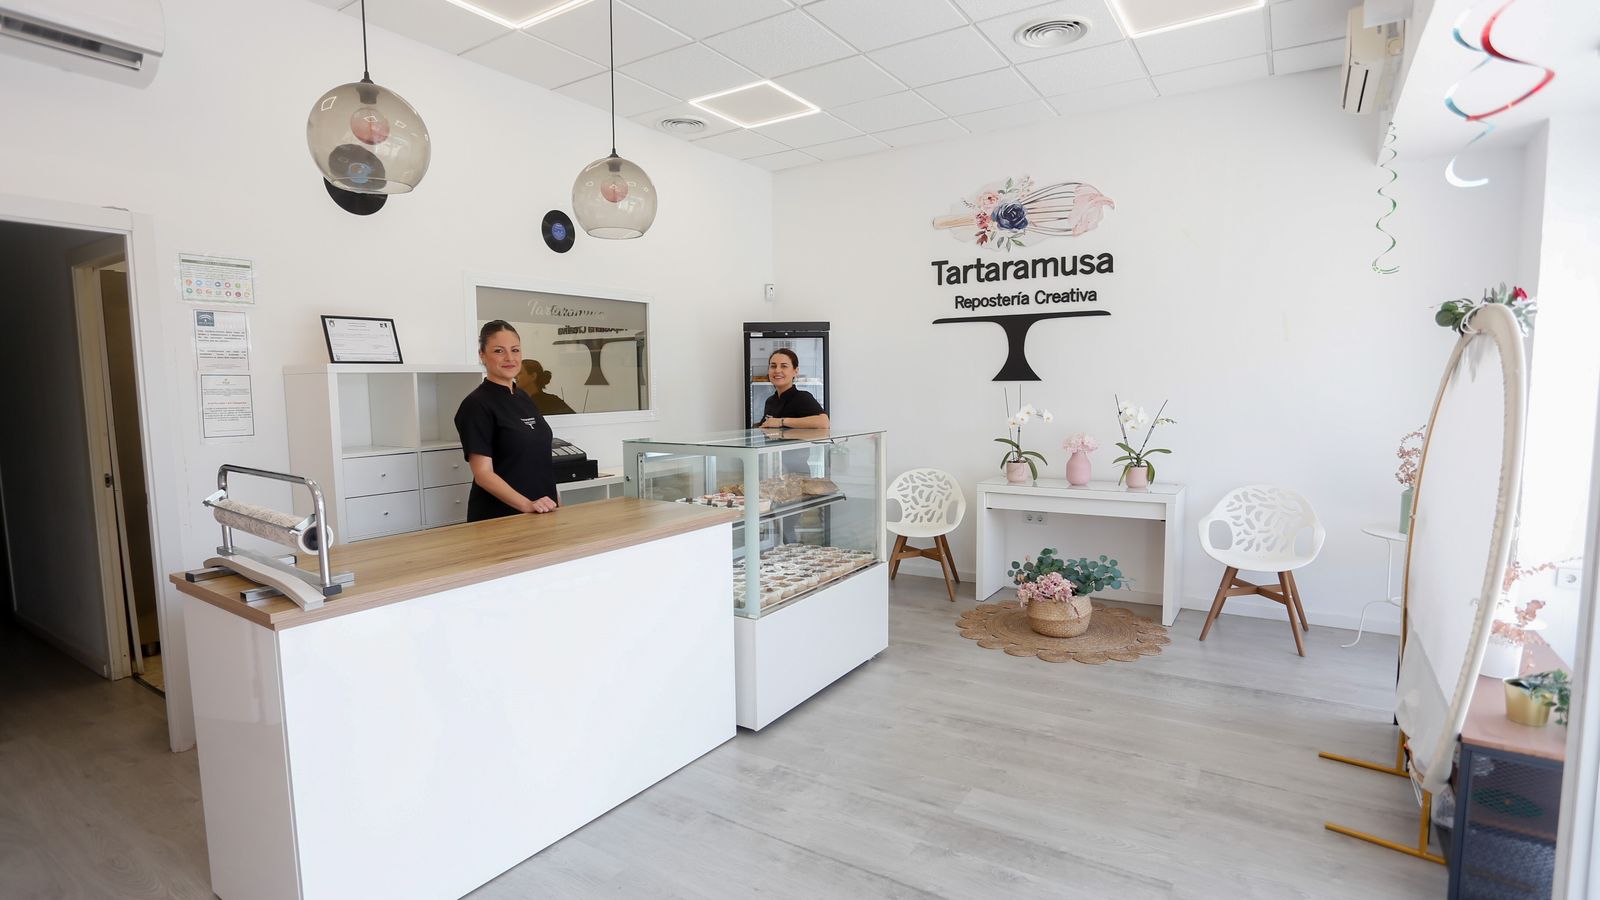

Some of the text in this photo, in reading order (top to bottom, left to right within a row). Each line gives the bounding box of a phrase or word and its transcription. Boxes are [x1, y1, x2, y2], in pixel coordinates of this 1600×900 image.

[931, 252, 1114, 286] Tartaramusa
[955, 288, 1098, 311] Repostería Creativa
